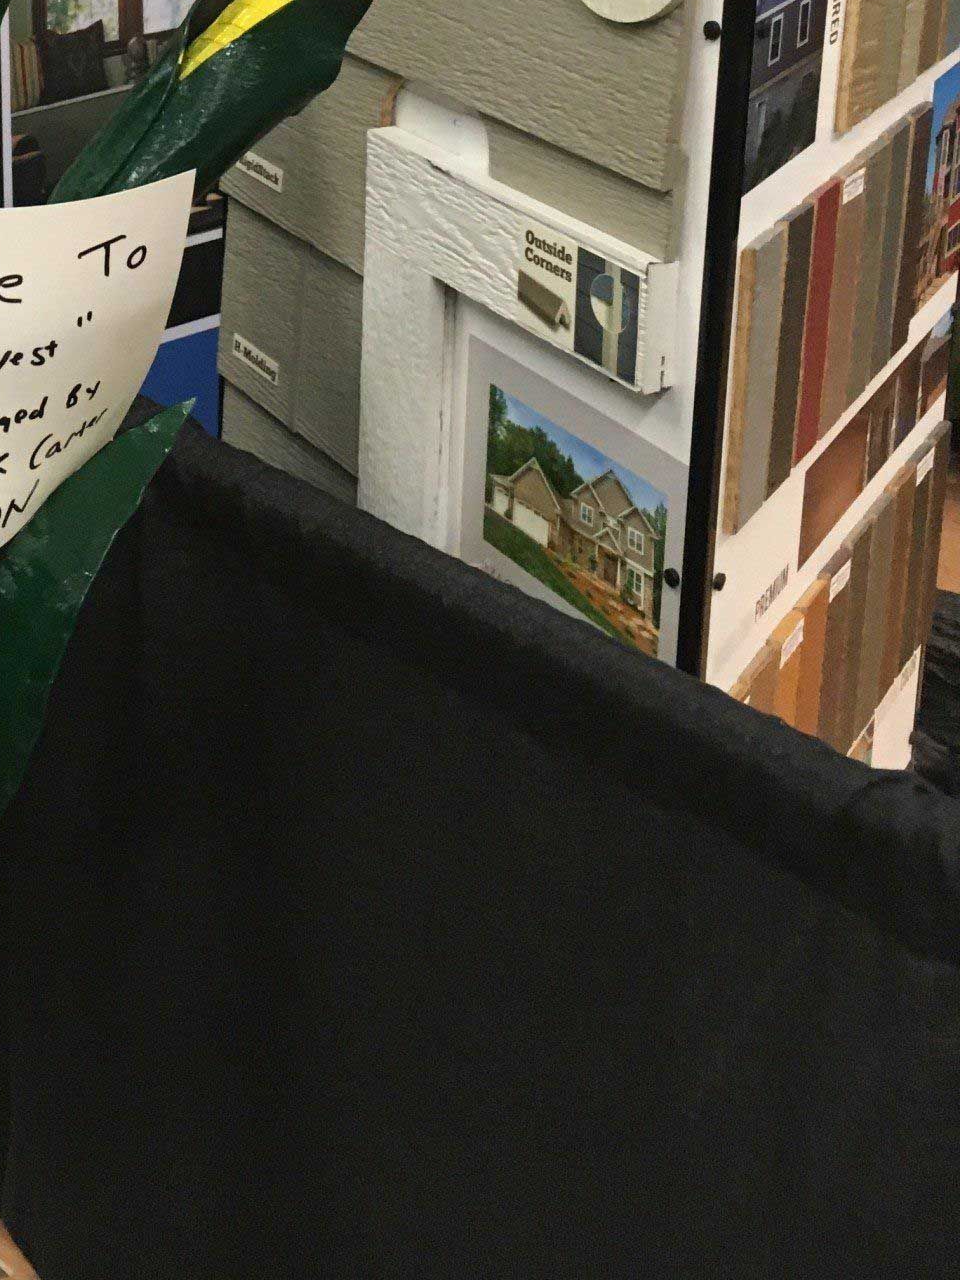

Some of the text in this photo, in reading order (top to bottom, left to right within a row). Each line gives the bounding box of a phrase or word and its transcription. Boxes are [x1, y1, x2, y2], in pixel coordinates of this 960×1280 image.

[78, 234, 147, 278] To
[524, 246, 572, 283] Corners
[525, 229, 573, 265] Outside
